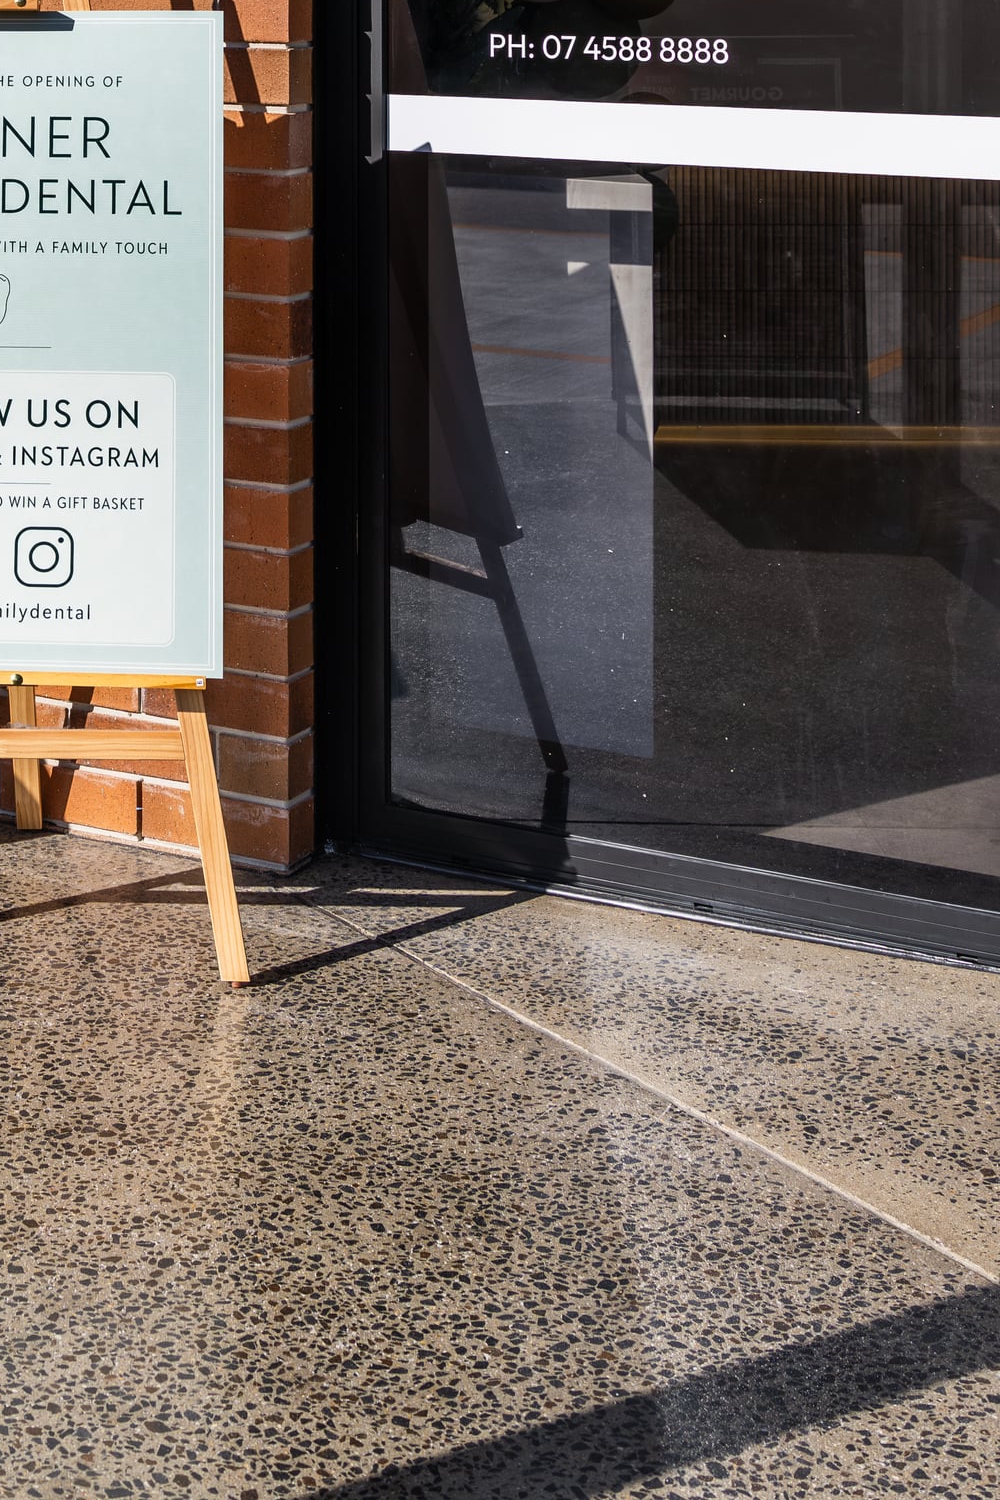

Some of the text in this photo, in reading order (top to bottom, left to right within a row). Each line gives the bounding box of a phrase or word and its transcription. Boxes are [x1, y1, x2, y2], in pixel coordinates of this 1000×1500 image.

[490, 33, 729, 65] PH: 07 4588 8888
[22, 75, 95, 88] OPENING
[102, 75, 123, 88] OF
[1, 178, 183, 216] DENTAL
[35, 241, 45, 254] A
[52, 241, 108, 254] FAMILY
[114, 241, 168, 255] TOUCH
[27, 398, 72, 429] US
[85, 399, 139, 429] ON
[12, 445, 159, 468] INSTAGRAM
[8, 495, 36, 509] WIN
[42, 496, 52, 509] A
[57, 496, 88, 509] GIFT
[93, 497, 145, 511] BASKET
